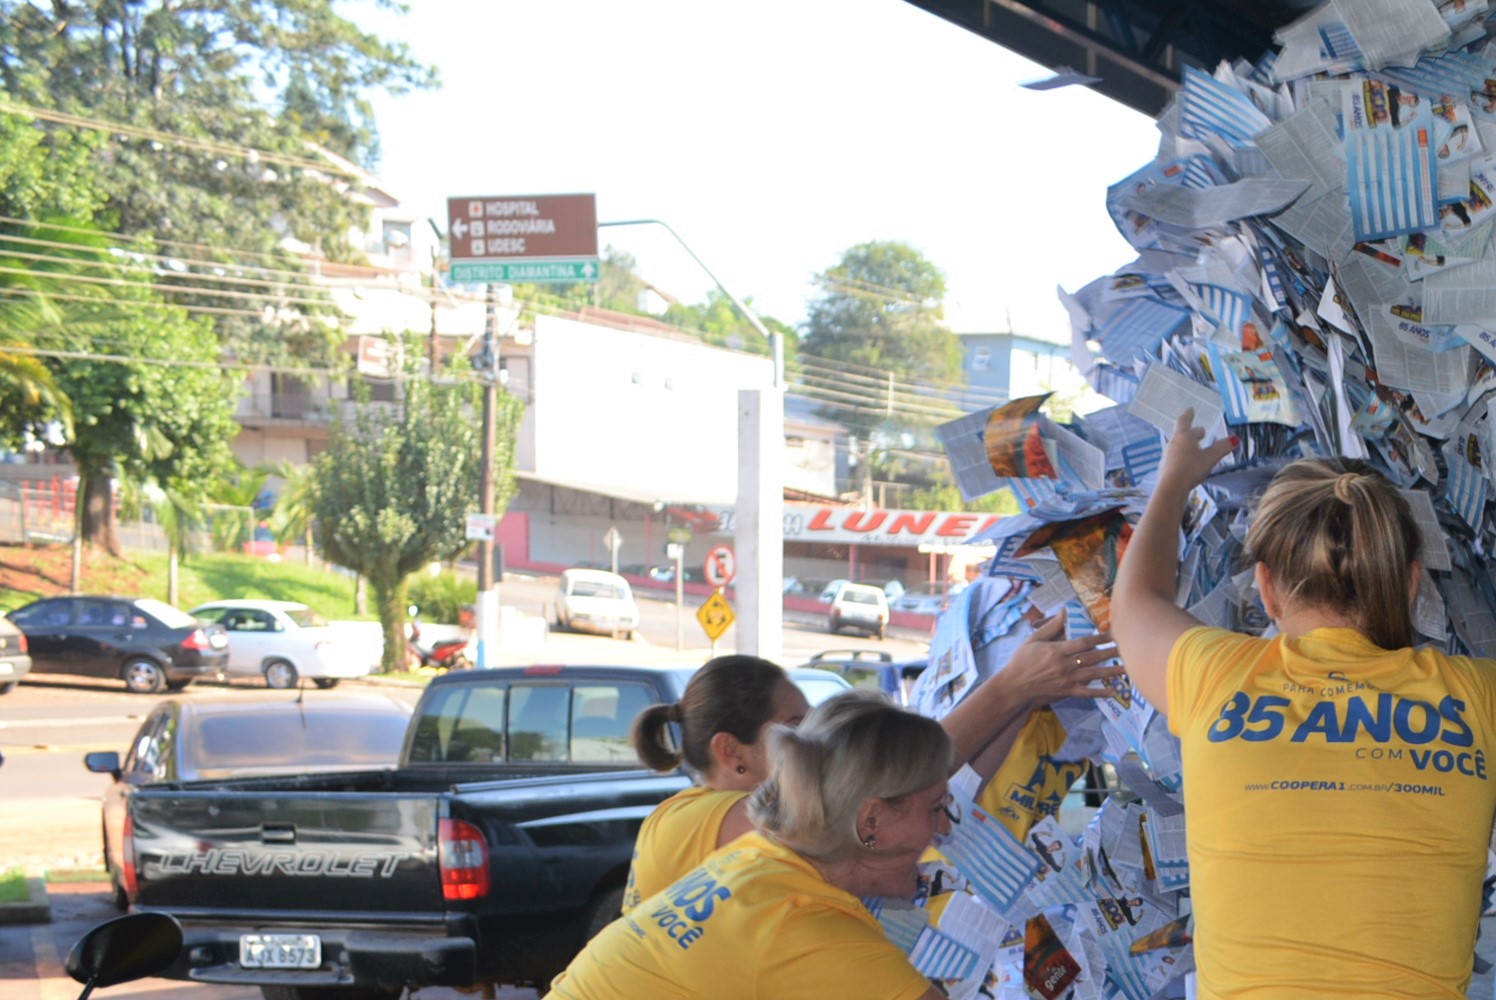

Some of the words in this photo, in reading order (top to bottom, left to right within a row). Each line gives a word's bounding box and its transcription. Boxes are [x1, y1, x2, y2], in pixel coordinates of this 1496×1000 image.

[486, 201, 540, 217] HOSPITAL
[487, 217, 556, 234] RODOVIÁRIA
[488, 238, 526, 253] UDESC
[454, 266, 503, 280] DISTRITO
[508, 264, 577, 279] DIAMANTINA
[808, 508, 1000, 537] LUNE
[1207, 691, 1291, 743] 85
[1290, 693, 1475, 748] ANOS
[1356, 748, 1403, 760] COM
[1409, 749, 1488, 780] VOCÊ
[159, 849, 408, 878] CHEVROLET
[651, 905, 704, 950] VOCÊ
